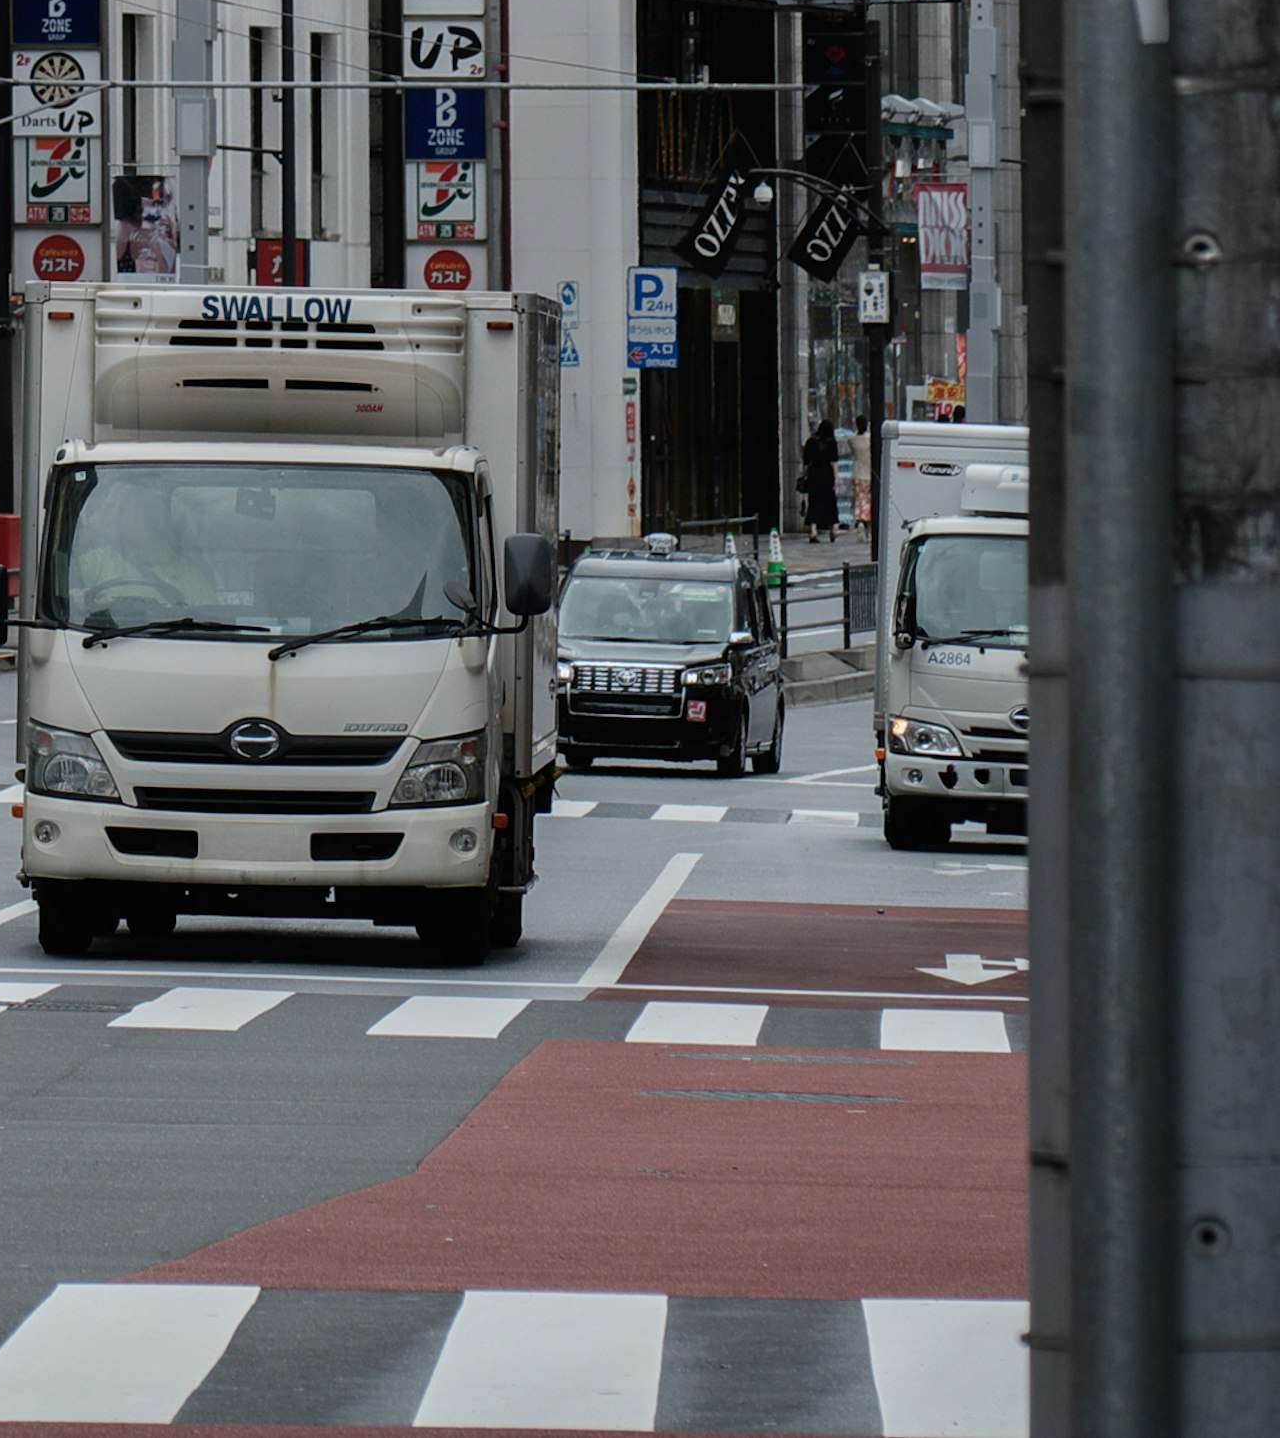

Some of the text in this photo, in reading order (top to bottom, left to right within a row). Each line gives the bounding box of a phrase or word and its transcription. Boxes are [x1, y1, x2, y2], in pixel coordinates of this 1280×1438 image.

[41, 19, 72, 33] ZONE
[410, 26, 482, 71] UP
[16, 54, 31, 66] 2F
[21, 111, 94, 133] Darts UP
[427, 128, 465, 146] ZONE
[39, 259, 79, 272] ガスト
[430, 270, 468, 284] ガスト
[634, 274, 664, 311] P
[201, 294, 352, 324] SWALLOW
[927, 651, 972, 667] A2864
